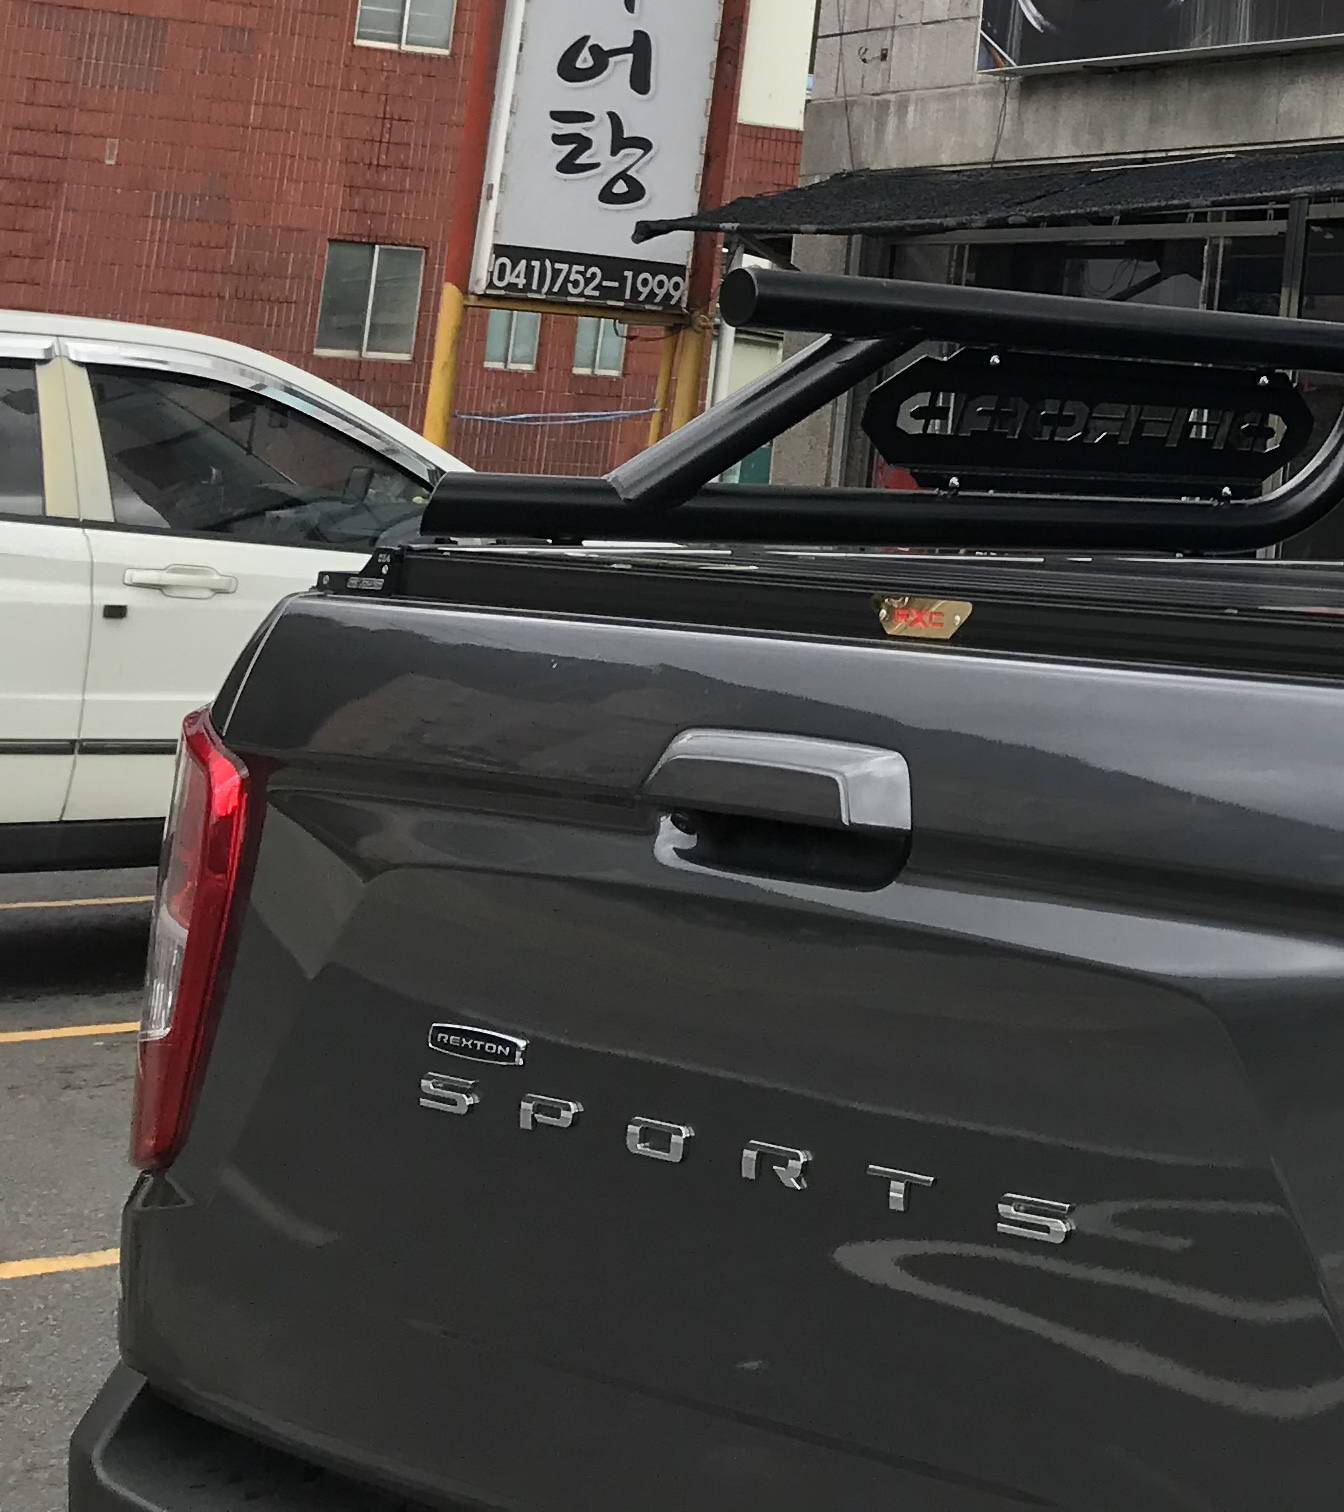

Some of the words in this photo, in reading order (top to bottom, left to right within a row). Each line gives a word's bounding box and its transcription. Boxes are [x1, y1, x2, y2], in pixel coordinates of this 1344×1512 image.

[491, 256, 686, 305] 041)752-1999
[437, 1032, 510, 1057] REXTON
[419, 1071, 1076, 1244] SPORTS
